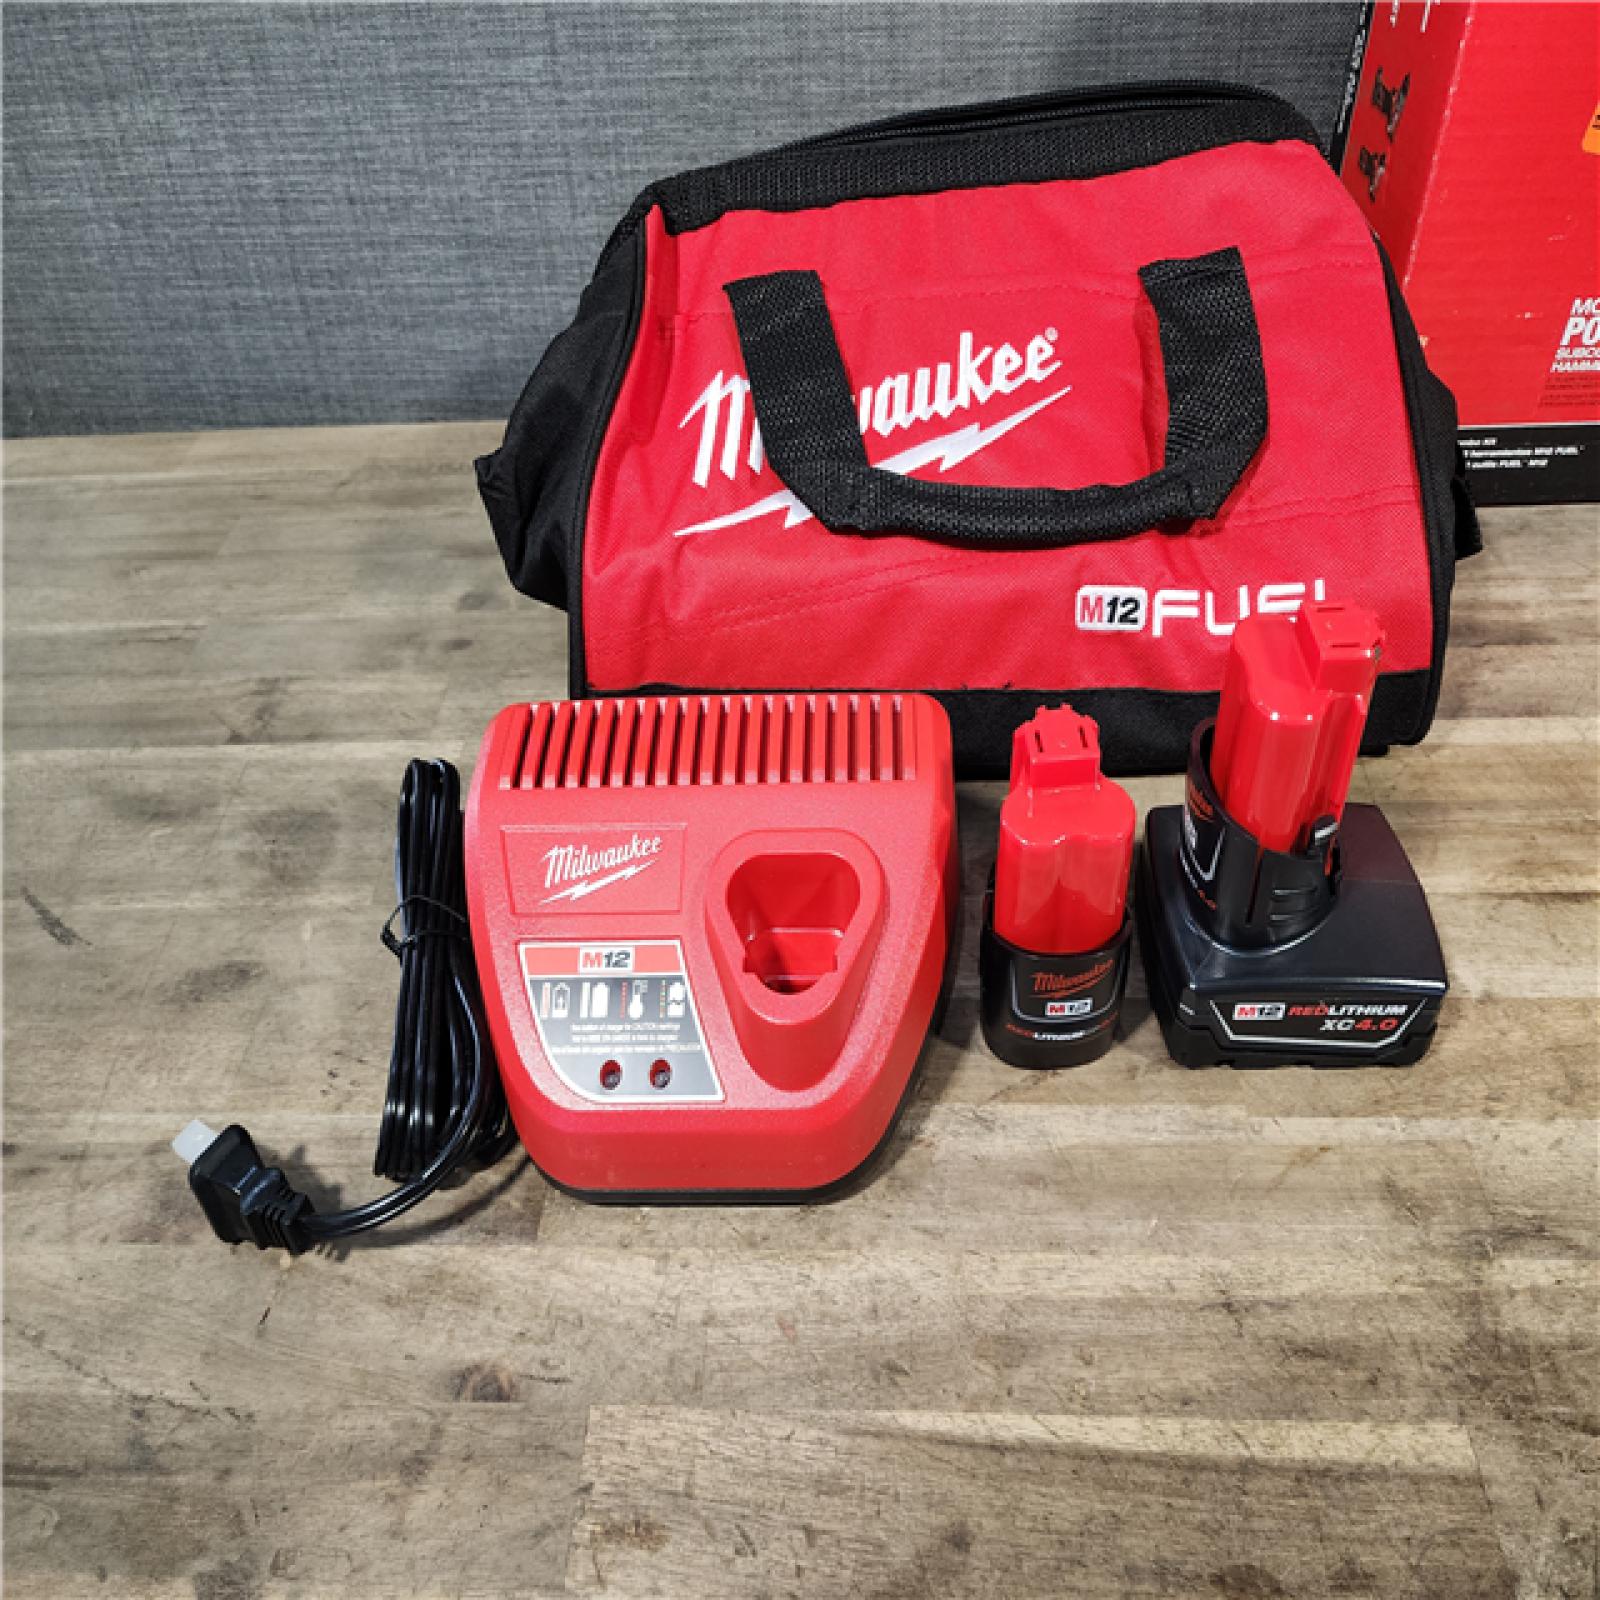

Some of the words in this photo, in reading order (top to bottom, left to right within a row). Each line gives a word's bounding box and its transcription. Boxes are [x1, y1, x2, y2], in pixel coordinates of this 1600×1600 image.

[679, 331, 1063, 488] Maukee
[1079, 593, 1142, 625] M12
[541, 832, 663, 888] Milwaukee
[582, 951, 631, 969] M12
[1048, 1001, 1090, 1014] M12
[1236, 1005, 1282, 1018] M12
[1287, 1003, 1409, 1016] REDLITHIUM
